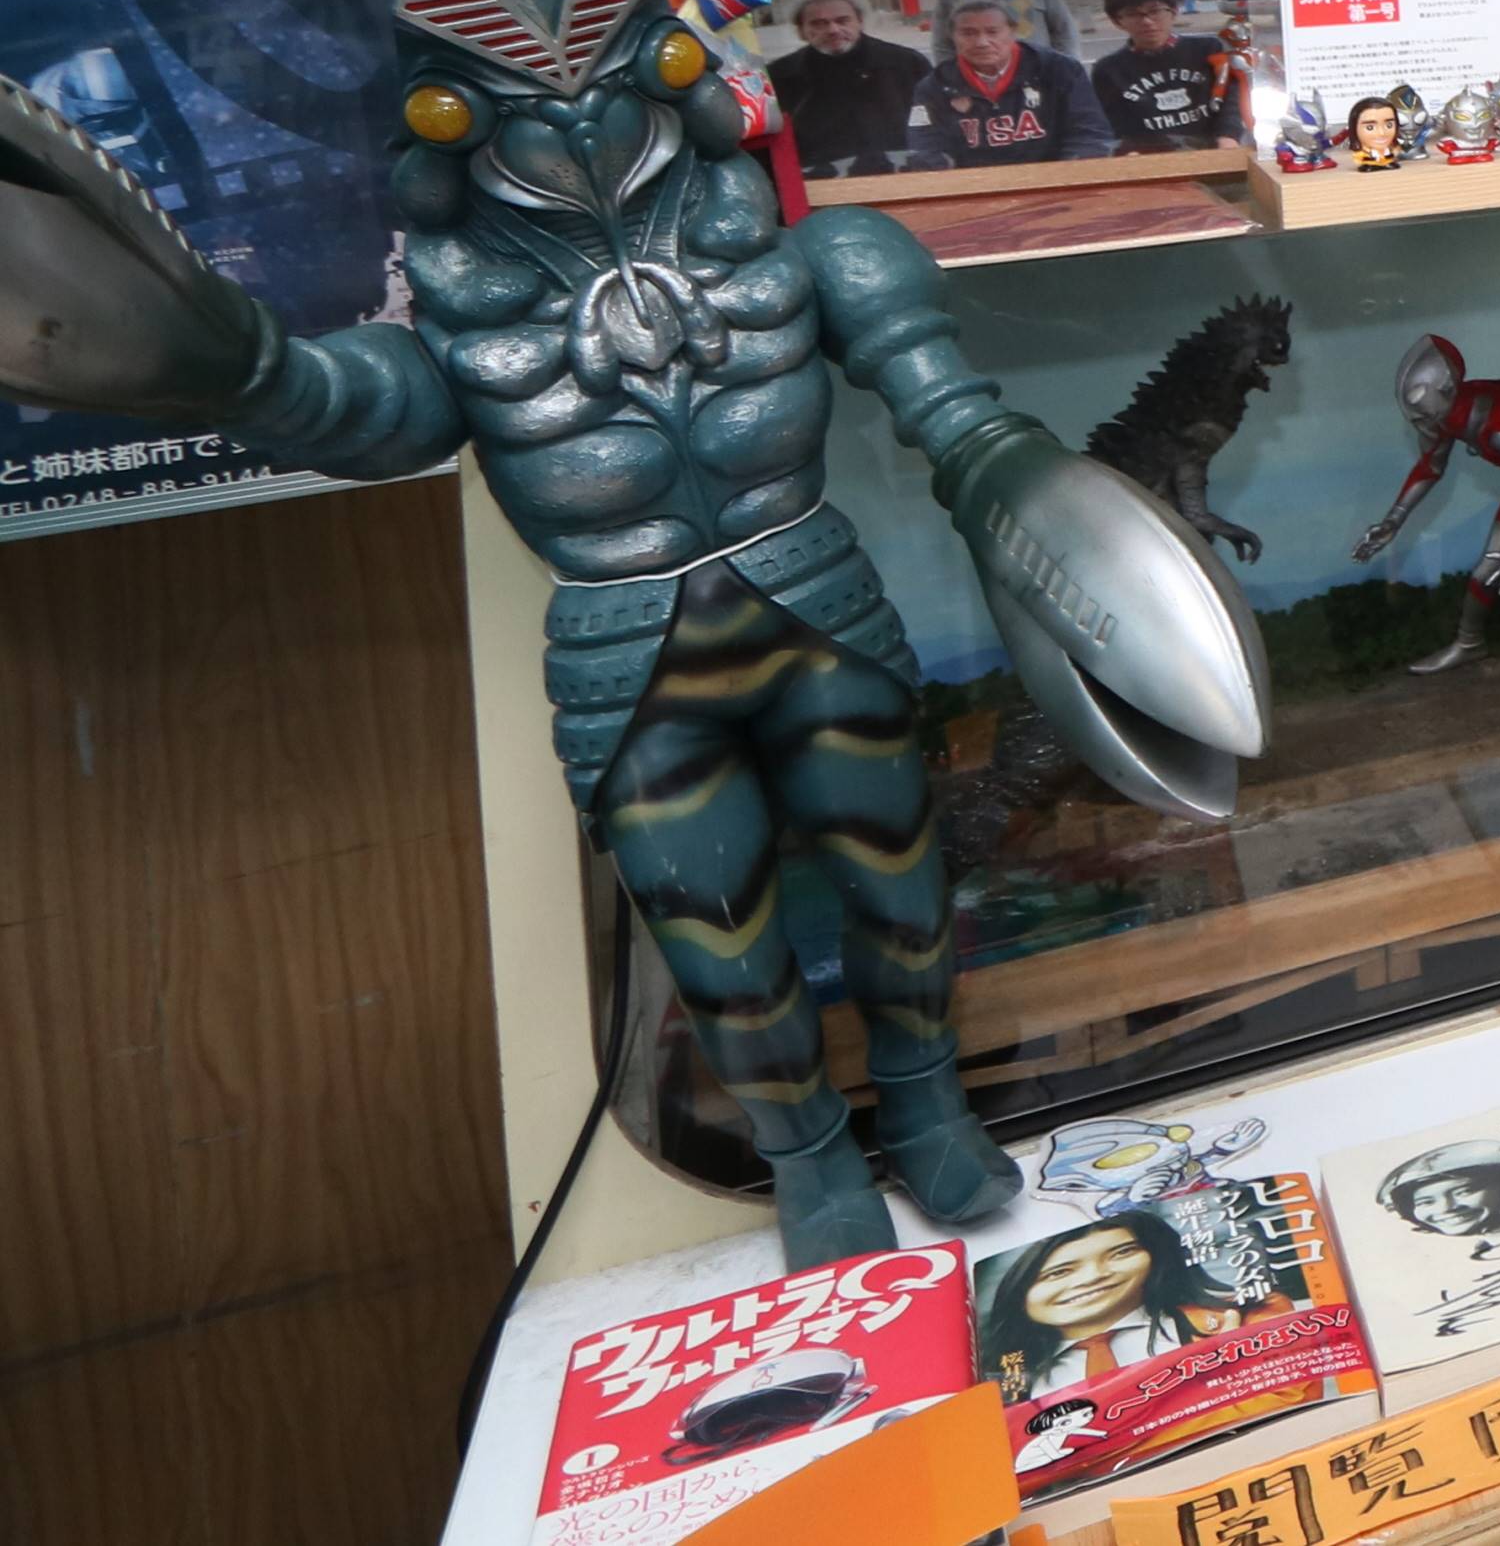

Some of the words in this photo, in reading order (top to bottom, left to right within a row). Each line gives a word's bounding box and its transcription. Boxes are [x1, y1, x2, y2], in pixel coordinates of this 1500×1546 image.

[1348, 3, 1397, 23] 第一号
[960, 109, 1047, 148] USA
[1214, 1190, 1272, 1306] ウルトラの女神
[1247, 1179, 1325, 1271] ヒロコ
[573, 1248, 957, 1385] ウルトラQ
[595, 1293, 913, 1420] ウルトラマン
